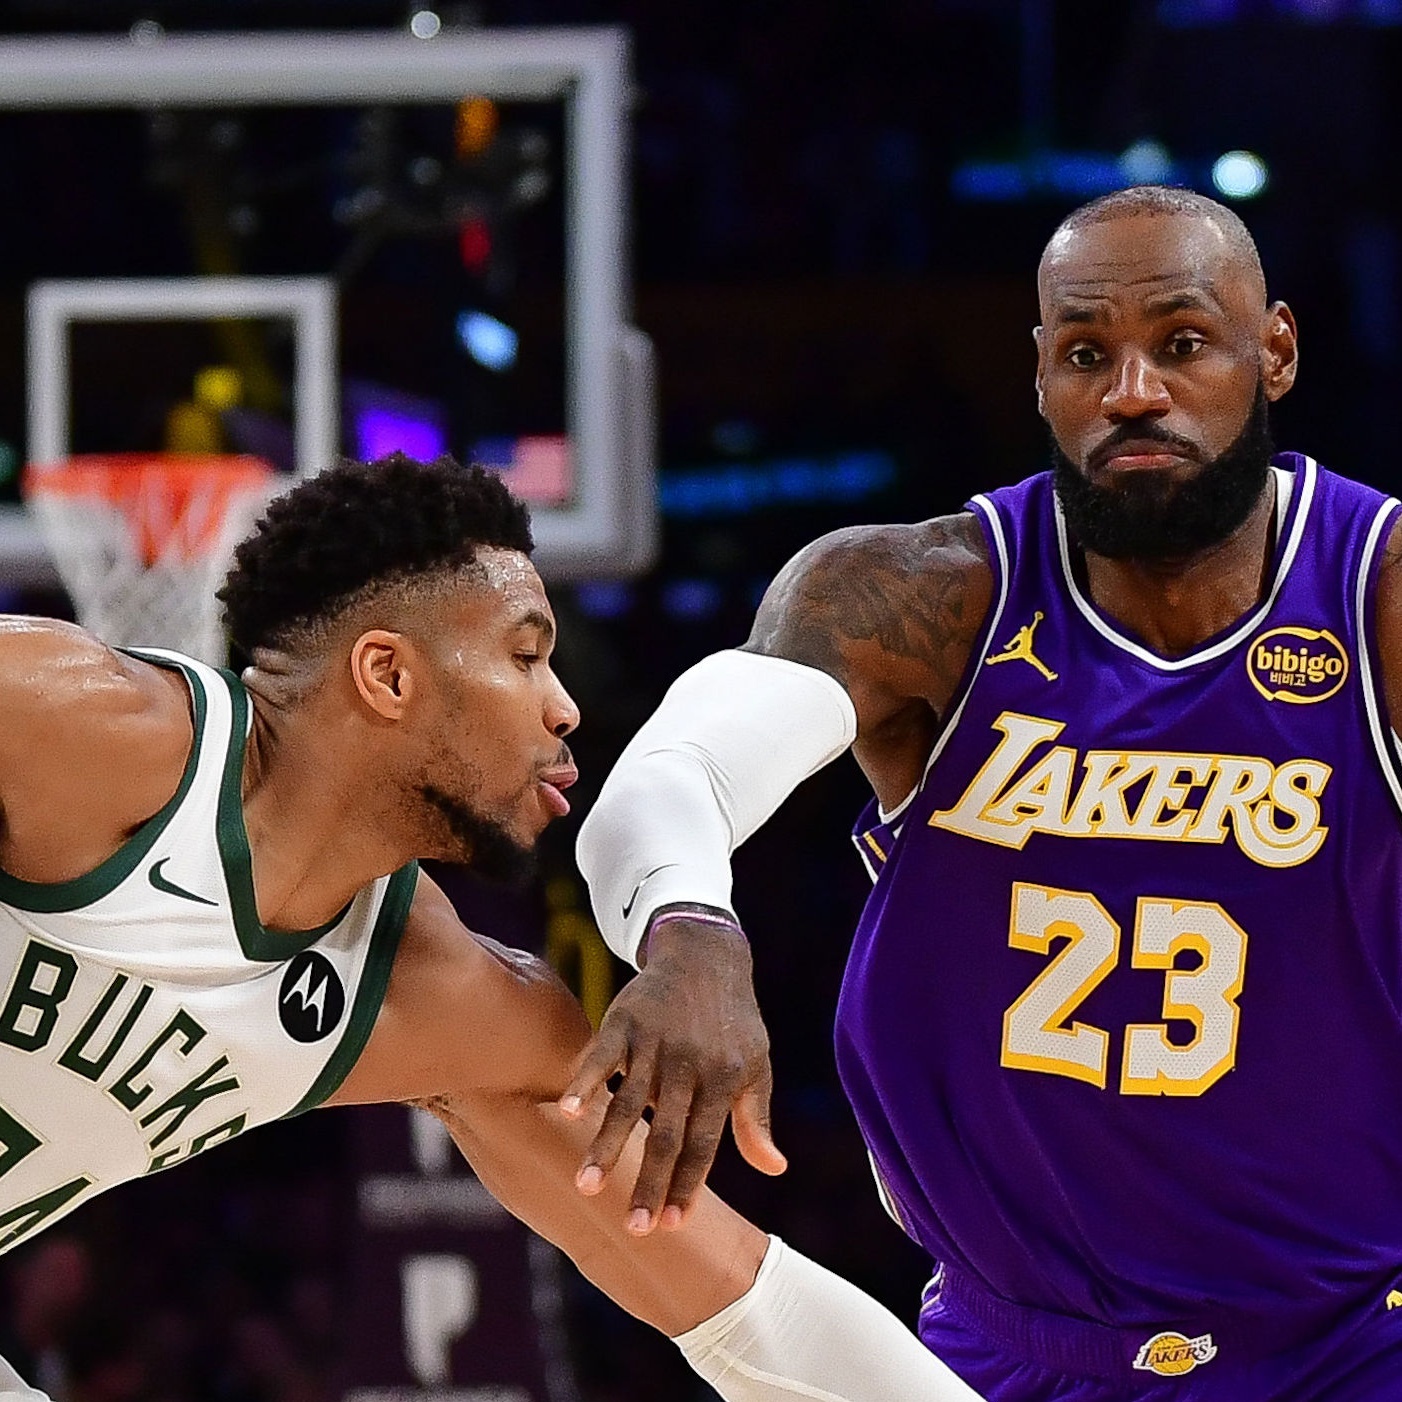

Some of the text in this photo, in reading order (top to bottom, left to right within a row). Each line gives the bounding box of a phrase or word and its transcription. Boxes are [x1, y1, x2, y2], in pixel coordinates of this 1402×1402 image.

[1256, 644, 1343, 684] bibigo
[1269, 671, 1307, 687] 비비고
[927, 711, 1334, 868] LAKERS
[1000, 881, 1249, 1097] 23
[1134, 1342, 1217, 1367] LAKERS
